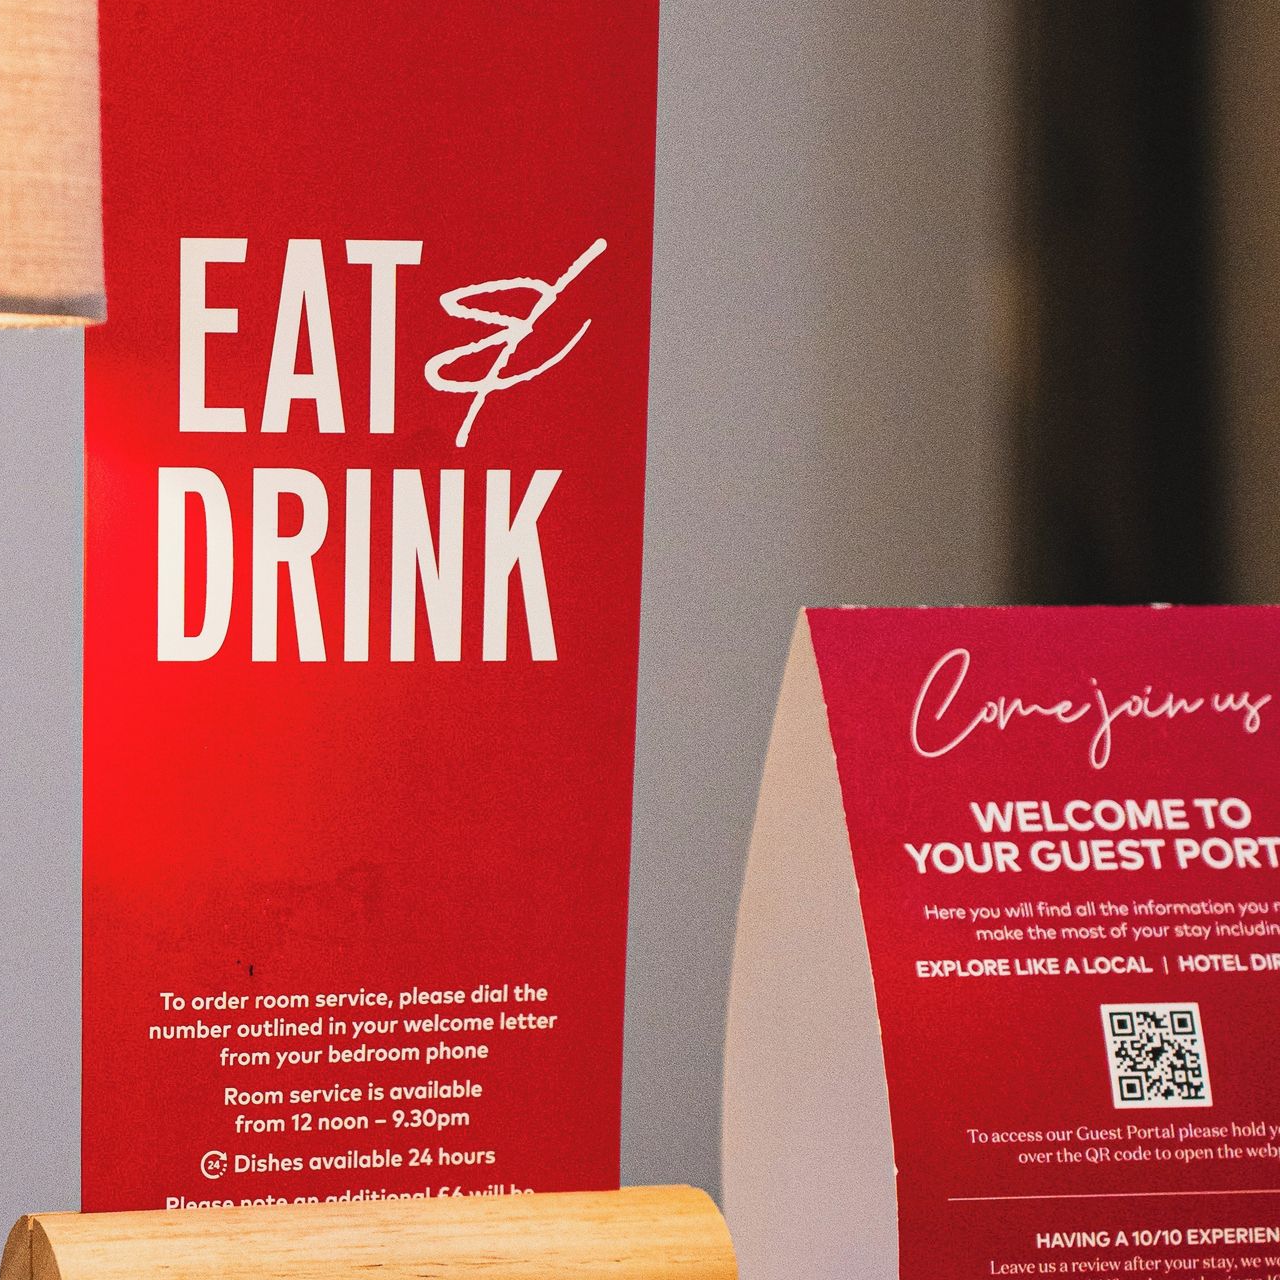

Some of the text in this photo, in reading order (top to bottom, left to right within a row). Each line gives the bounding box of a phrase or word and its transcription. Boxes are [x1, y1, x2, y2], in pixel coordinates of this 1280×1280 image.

[178, 237, 608, 448] EAT &
[157, 466, 563, 663] DRINK
[910, 647, 1272, 770] Come join us
[969, 797, 1252, 833] WELCOME TO
[904, 841, 1022, 874] YOUR
[1029, 838, 1166, 873] GUEST
[923, 904, 967, 920] Here
[969, 907, 1001, 923] you
[1004, 902, 1034, 918] will
[1036, 901, 1072, 918] find
[1075, 900, 1097, 917] all
[1099, 900, 1129, 917] the
[1132, 899, 1235, 916] information
[1237, 901, 1269, 917] you
[975, 925, 1024, 942] make
[1026, 924, 1057, 941] the
[1061, 924, 1107, 940] most
[1109, 921, 1128, 939] of
[1131, 925, 1170, 942] your
[1174, 923, 1212, 940] stay
[915, 958, 1012, 978] EXPLORE
[1014, 957, 1061, 976] LIKE
[1064, 957, 1081, 975] A
[1082, 955, 1154, 975] LOCAL
[1178, 953, 1249, 973] HOTEL
[159, 983, 548, 1011] To order room service, please dial the
[149, 1011, 558, 1040] number outlined in your welcome letter
[219, 1041, 489, 1070] from your bedroom phone
[224, 1079, 483, 1106] Room service is available
[234, 1114, 286, 1134] from
[291, 1112, 313, 1132] 12
[318, 1115, 369, 1131] noon
[391, 1108, 470, 1131] 9.30pm
[966, 1128, 989, 1144] To
[991, 1130, 1044, 1143] access
[1045, 1130, 1074, 1142] our
[1076, 1126, 1123, 1141] Guest
[1126, 1123, 1175, 1140] Portal
[1178, 1123, 1229, 1142] please
[1231, 1121, 1266, 1137] hold
[207, 1160, 220, 1170] 24
[234, 1147, 496, 1173] Dishes available 24 hours
[1018, 1152, 1054, 1164] over
[1056, 1147, 1083, 1163] the
[1084, 1147, 1111, 1164] QR
[1113, 1145, 1152, 1162] code
[1154, 1148, 1172, 1161] to
[1174, 1148, 1214, 1164] open
[1216, 1143, 1243, 1159] the
[1036, 1226, 1280, 1249] HAVING A 10/10 EXPERIEN
[990, 1260, 1036, 1275] Leave
[1038, 1262, 1057, 1274] us
[1059, 1262, 1068, 1273] a
[1071, 1257, 1121, 1273] review
[1124, 1255, 1162, 1271] after
[1164, 1258, 1200, 1274] your
[1202, 1256, 1238, 1273] stay,
[1240, 1257, 1262, 1268] we
